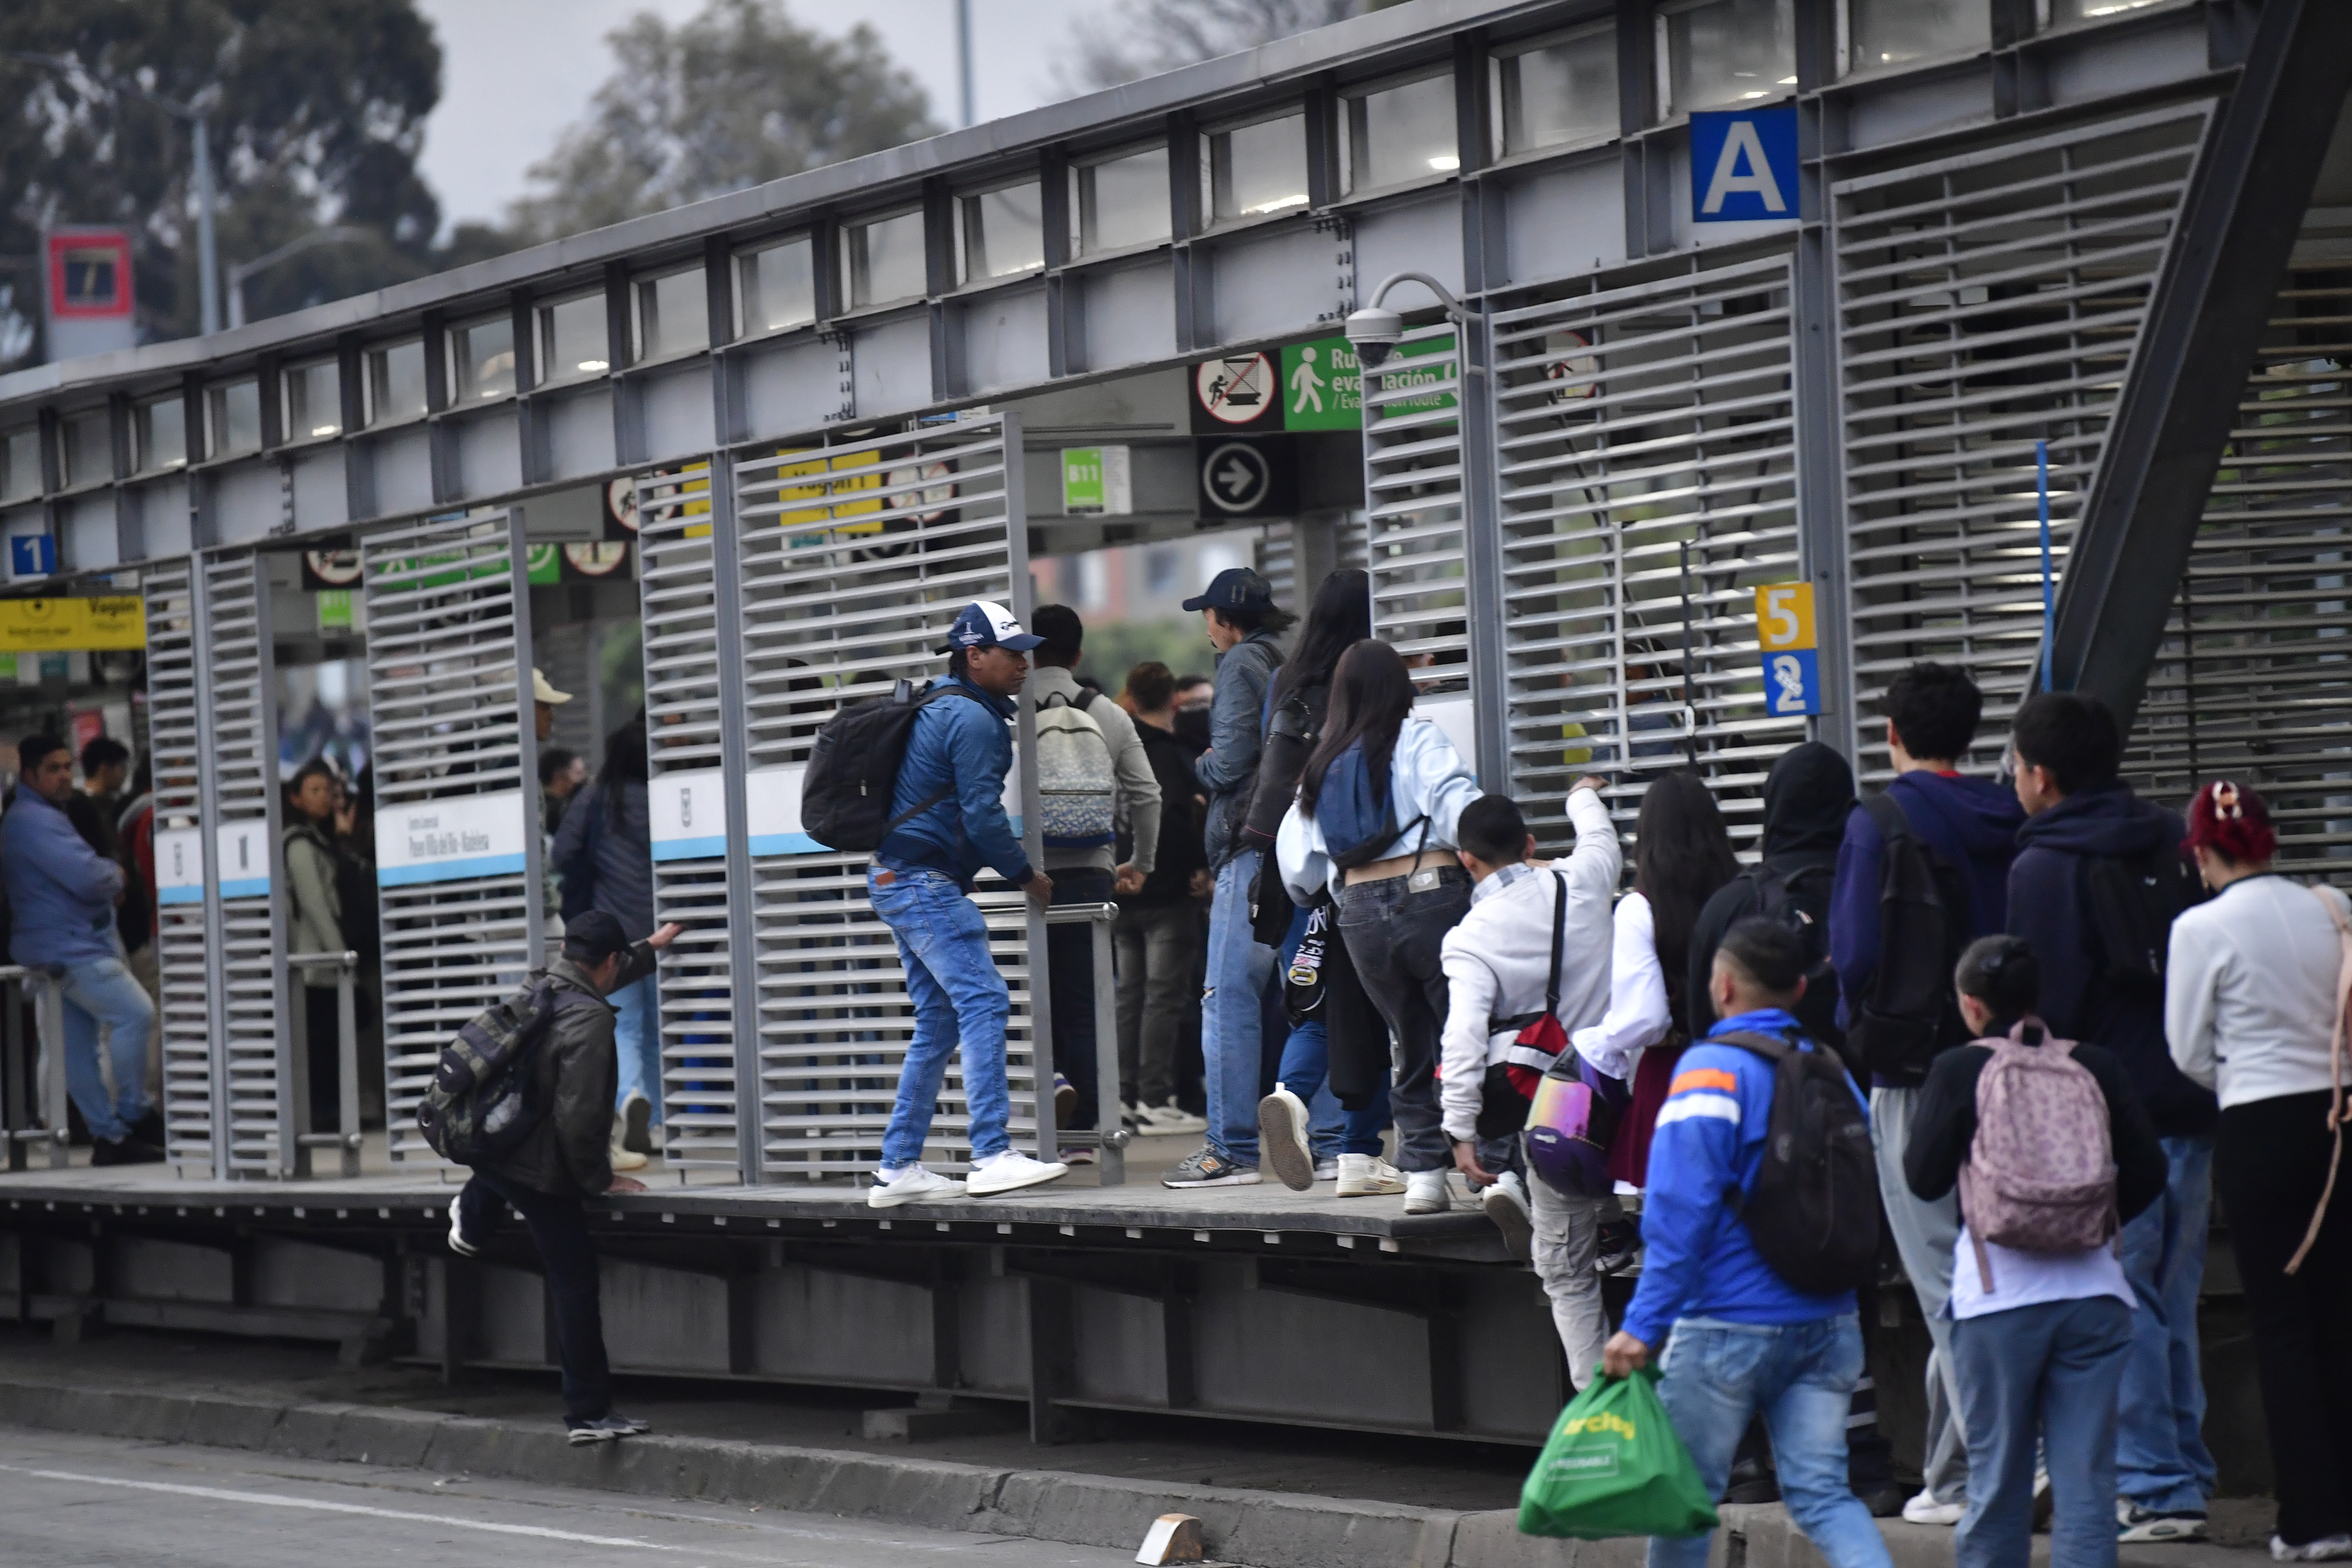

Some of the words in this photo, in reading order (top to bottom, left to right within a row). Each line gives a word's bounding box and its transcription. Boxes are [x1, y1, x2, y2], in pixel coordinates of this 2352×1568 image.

[1701, 121, 1786, 213] A
[1069, 464, 1098, 483] B11
[22, 538, 44, 572] 1
[1768, 589, 1799, 645] 5
[1773, 655, 1806, 712] 2
[1199, 1156, 1222, 1173] N
